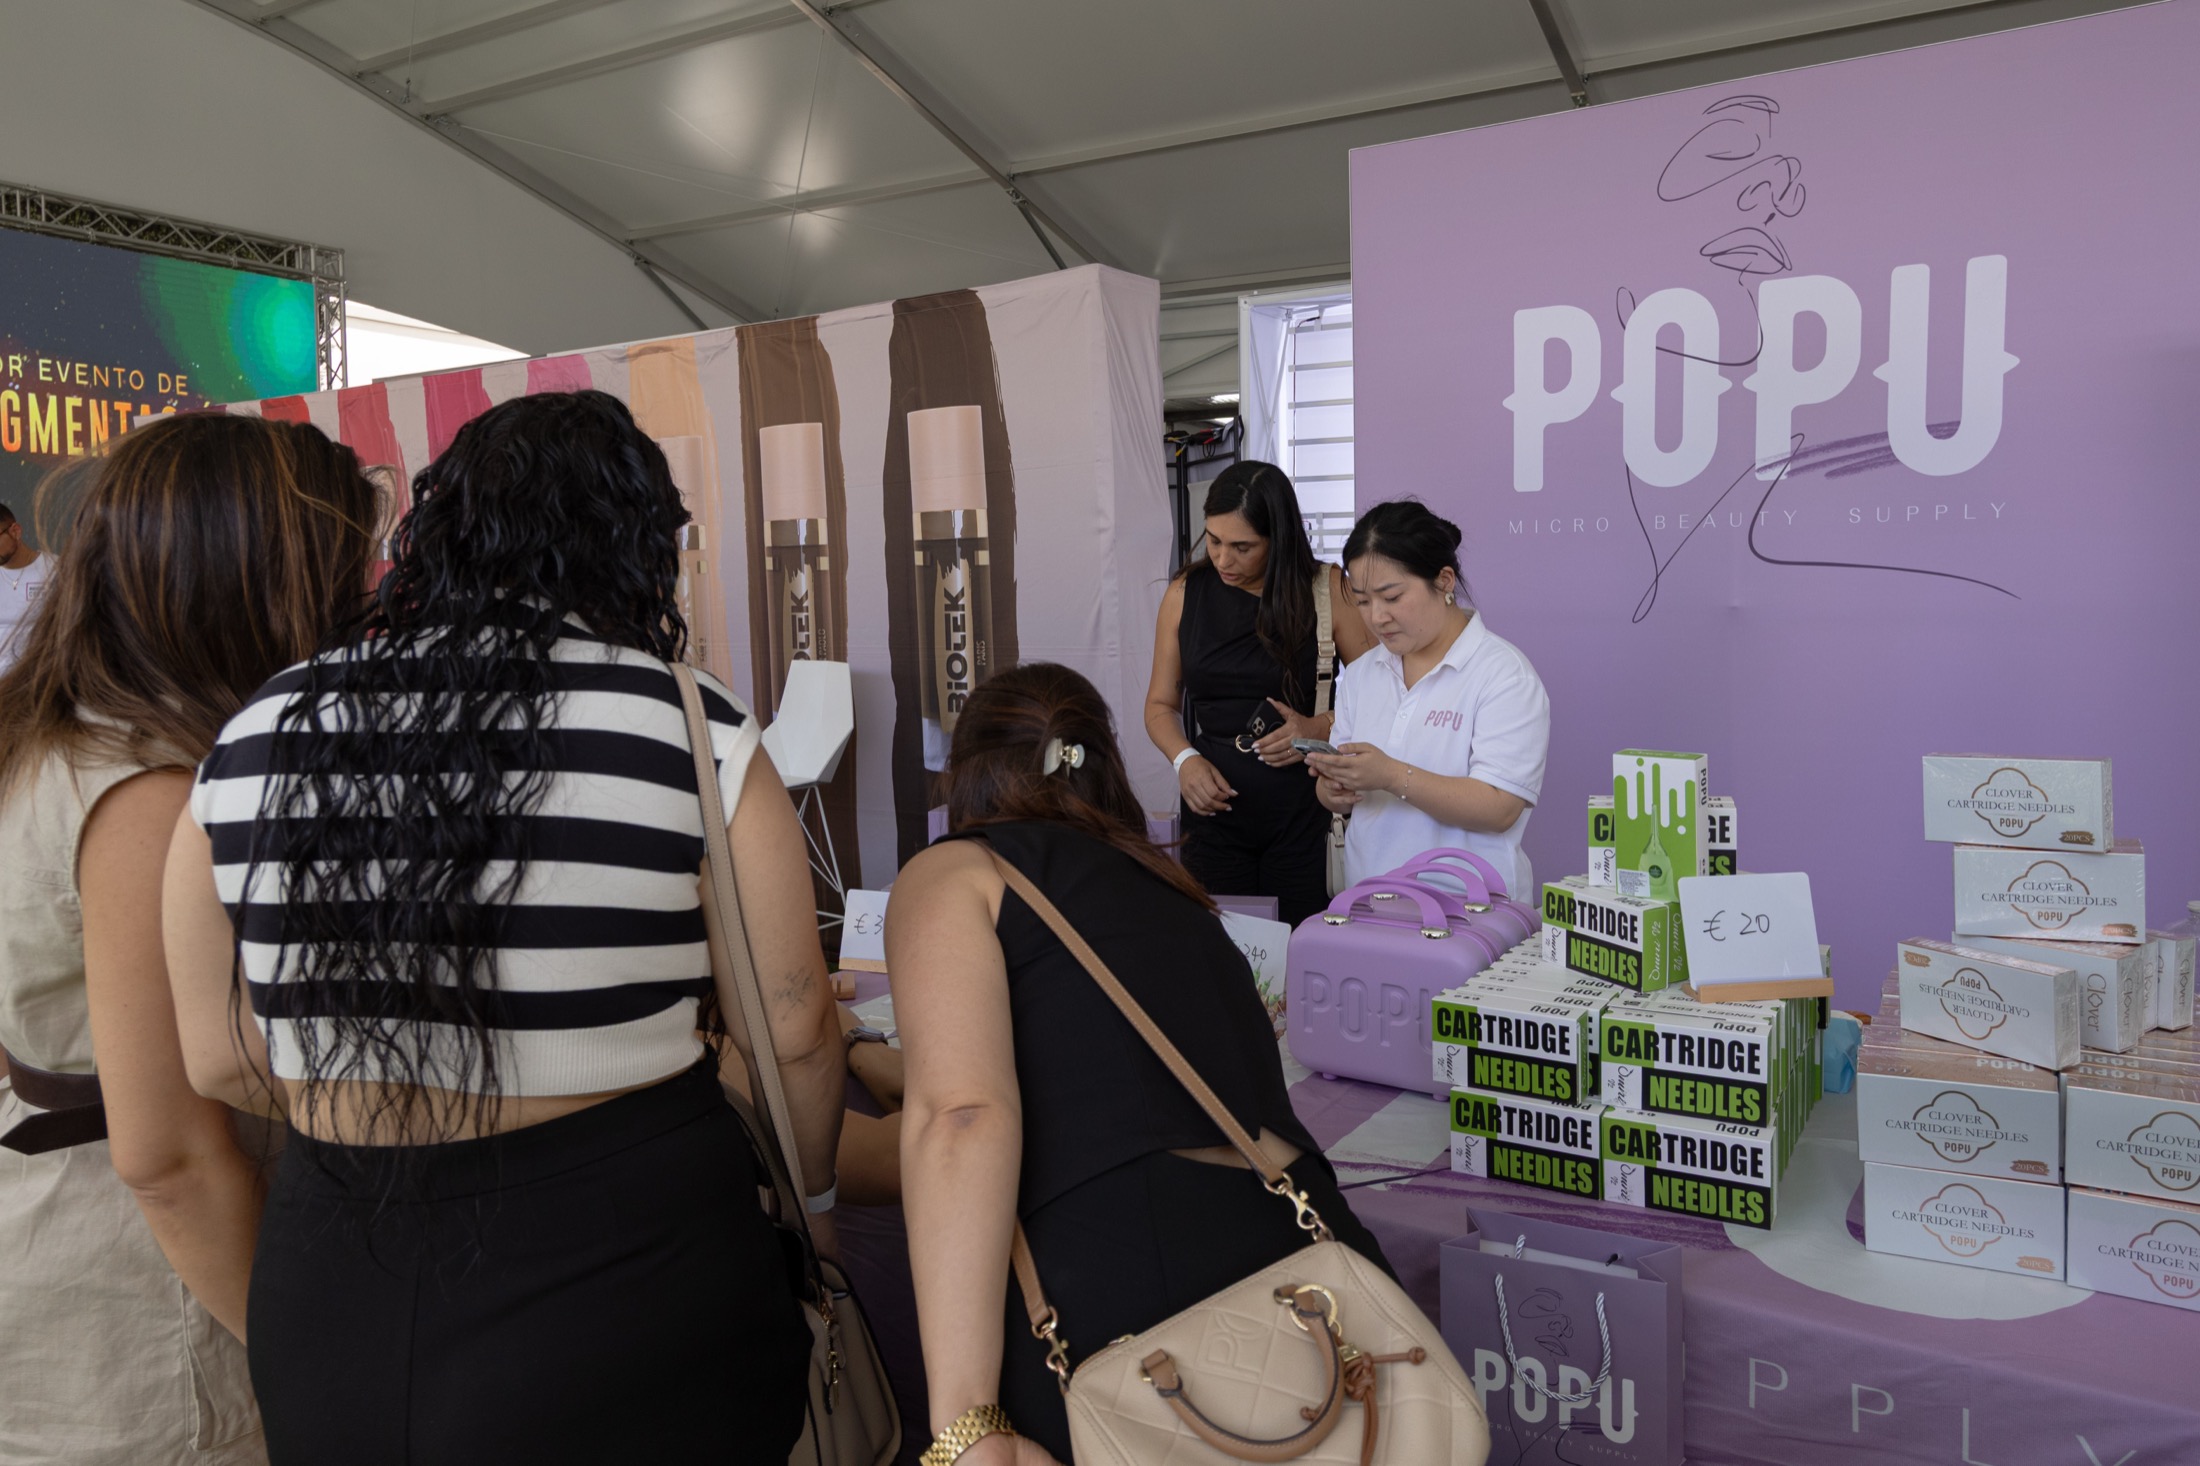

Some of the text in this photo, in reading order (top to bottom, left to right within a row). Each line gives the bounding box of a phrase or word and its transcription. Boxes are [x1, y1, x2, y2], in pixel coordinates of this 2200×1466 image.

[39, 358, 145, 391] EVENTO
[158, 372, 189, 396] DE
[1502, 254, 2021, 492] POPU
[1, 389, 177, 457] GMENT
[1508, 501, 2007, 535] MICRO BEAUTY SUPPLY
[976, 640, 986, 666] PARIS
[1424, 709, 1464, 732] POPU
[1700, 767, 1708, 806] POPU
[1985, 788, 2034, 799] CLOVER
[1947, 799, 2076, 814] CARTRIDGE NEEDLES
[1999, 818, 2024, 829] POPU
[2022, 881, 2074, 892] CLOVER
[1981, 892, 2118, 907] CARTRIDGE NEEDLES
[854, 912, 869, 935] €
[1545, 890, 1638, 944] CARTRIDGE
[1703, 909, 1770, 942] € 20
[2037, 911, 2063, 922] POPU
[1570, 937, 1638, 986] NEEDLES
[1563, 986, 1602, 997] POPU
[1959, 976, 1981, 990] POPU
[1530, 1005, 1570, 1016] POPU
[1553, 996, 1593, 1007] POPU
[1919, 983, 2030, 1018] CARTRIDGE NEEDLES
[2086, 973, 2107, 1031] Clover
[1952, 1004, 1995, 1023] CLOVER
[1436, 1007, 1571, 1056] CARTRIDGE
[1713, 1022, 1757, 1034] POPU
[1607, 1025, 1761, 1075] CARTRIDGE
[1473, 1054, 1572, 1100] NEEDLES
[1976, 1058, 2036, 1073] POPU
[2078, 1066, 2141, 1081] POPU
[1649, 1075, 1761, 1123] NEEDLES
[1455, 1097, 1593, 1151] CARTRIDGE
[1928, 1110, 1983, 1125] CLOVER
[1715, 1123, 1760, 1137] POPU
[1885, 1118, 2029, 1143] CARTRIDGE NEEDLES
[1608, 1124, 1765, 1179] CARTRIDGE
[1944, 1141, 1971, 1154] POPU
[2096, 1138, 2183, 1162] CARTRIDGE
[1493, 1146, 1593, 1194] NEEDLES
[2015, 1162, 2045, 1173] 20PCS
[2161, 1166, 2192, 1182] POPU
[1652, 1175, 1765, 1225] NEEDLES
[1934, 1203, 1989, 1220] CLOVER
[1891, 1209, 2035, 1239] CARTRIDGE NEEDLES
[1950, 1235, 1977, 1249] POPU
[2097, 1244, 2185, 1269] CARTRIDGE
[2163, 1274, 2194, 1290] POPU
[1471, 1347, 1640, 1444] POPU
